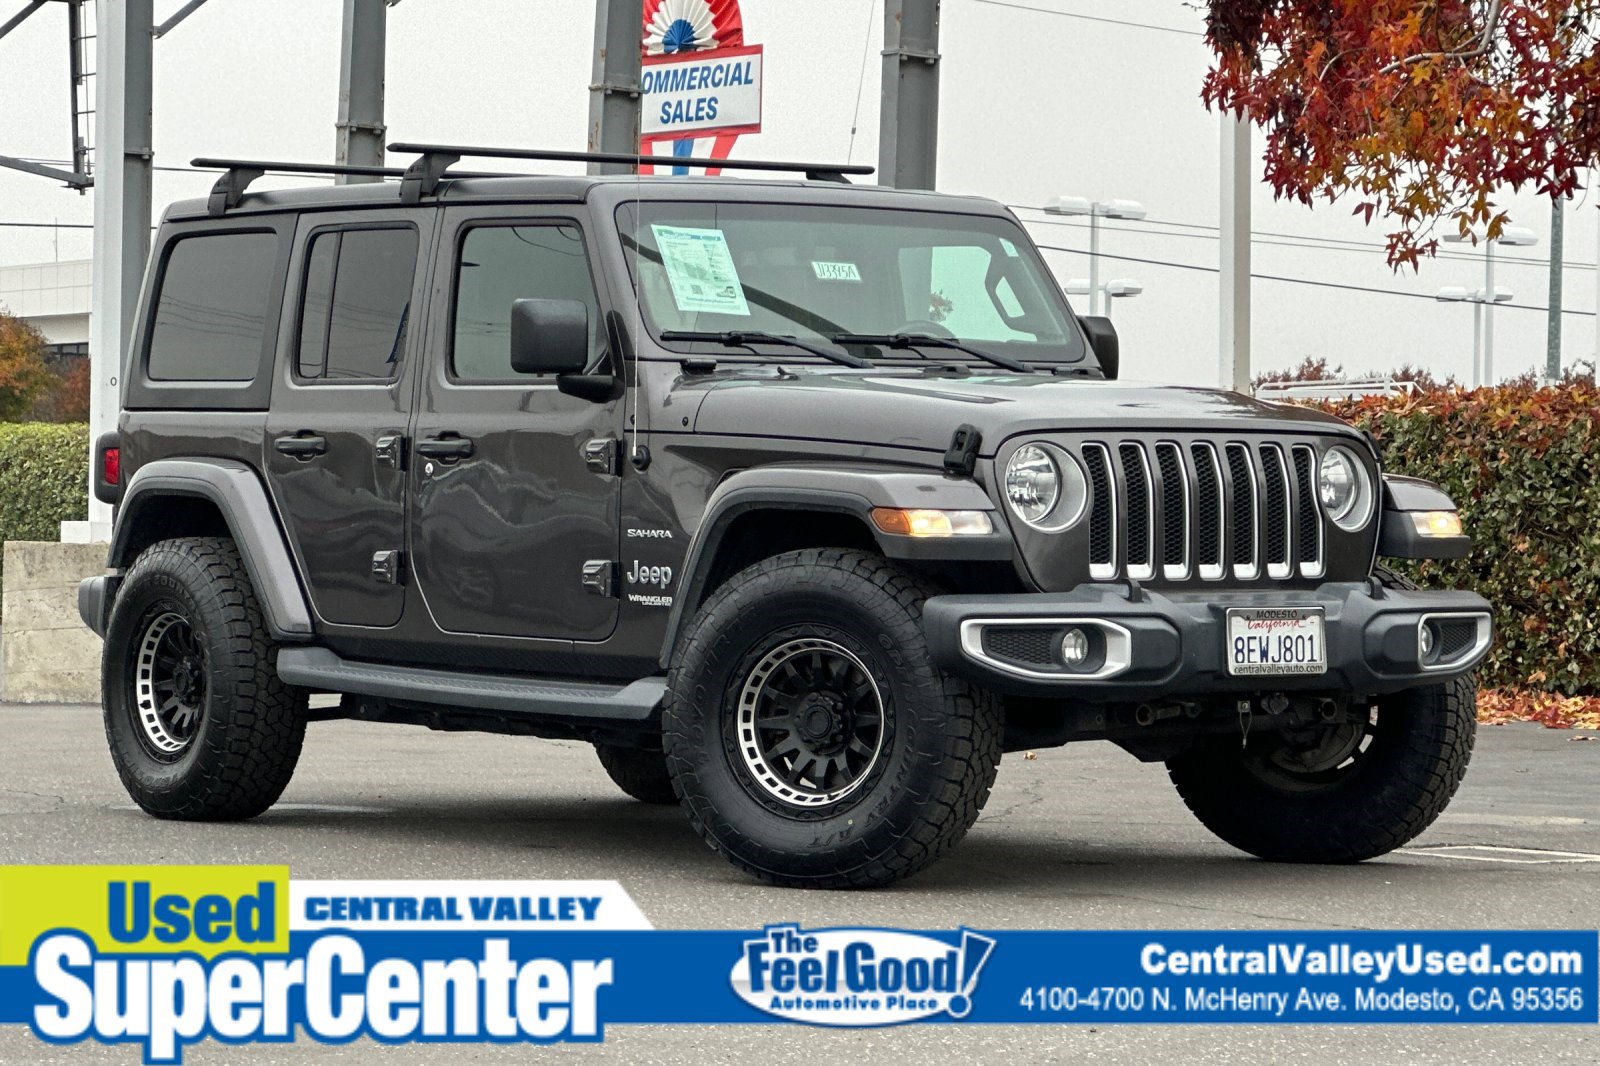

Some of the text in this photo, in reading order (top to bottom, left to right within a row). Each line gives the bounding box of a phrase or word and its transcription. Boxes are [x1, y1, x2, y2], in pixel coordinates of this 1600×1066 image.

[641, 61, 754, 95] OMMERCIAL
[660, 96, 719, 124] SALES
[627, 528, 672, 538] SAHARA
[626, 559, 672, 590] Jeep
[628, 594, 673, 604] WRANGLER
[1256, 610, 1298, 619] MODESTO
[1247, 619, 1307, 634] California
[1234, 634, 1318, 663] 8EWJ801
[1234, 663, 1324, 675] centralvalleyauto.com
